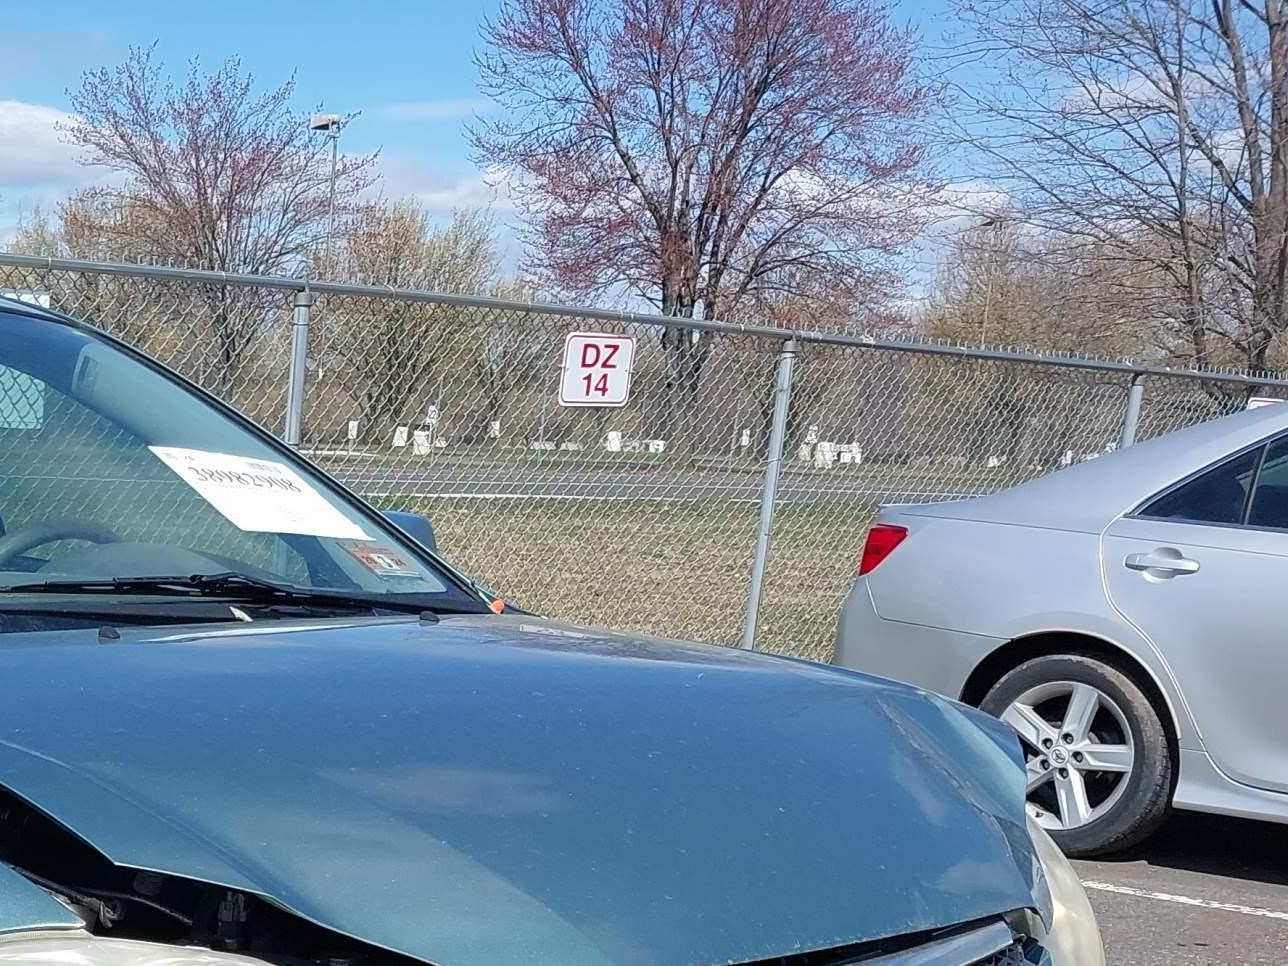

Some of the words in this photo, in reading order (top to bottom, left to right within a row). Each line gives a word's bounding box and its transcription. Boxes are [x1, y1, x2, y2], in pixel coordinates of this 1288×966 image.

[580, 343, 621, 369] DZ
[581, 372, 609, 397] 14
[187, 466, 302, 493] 38982908
